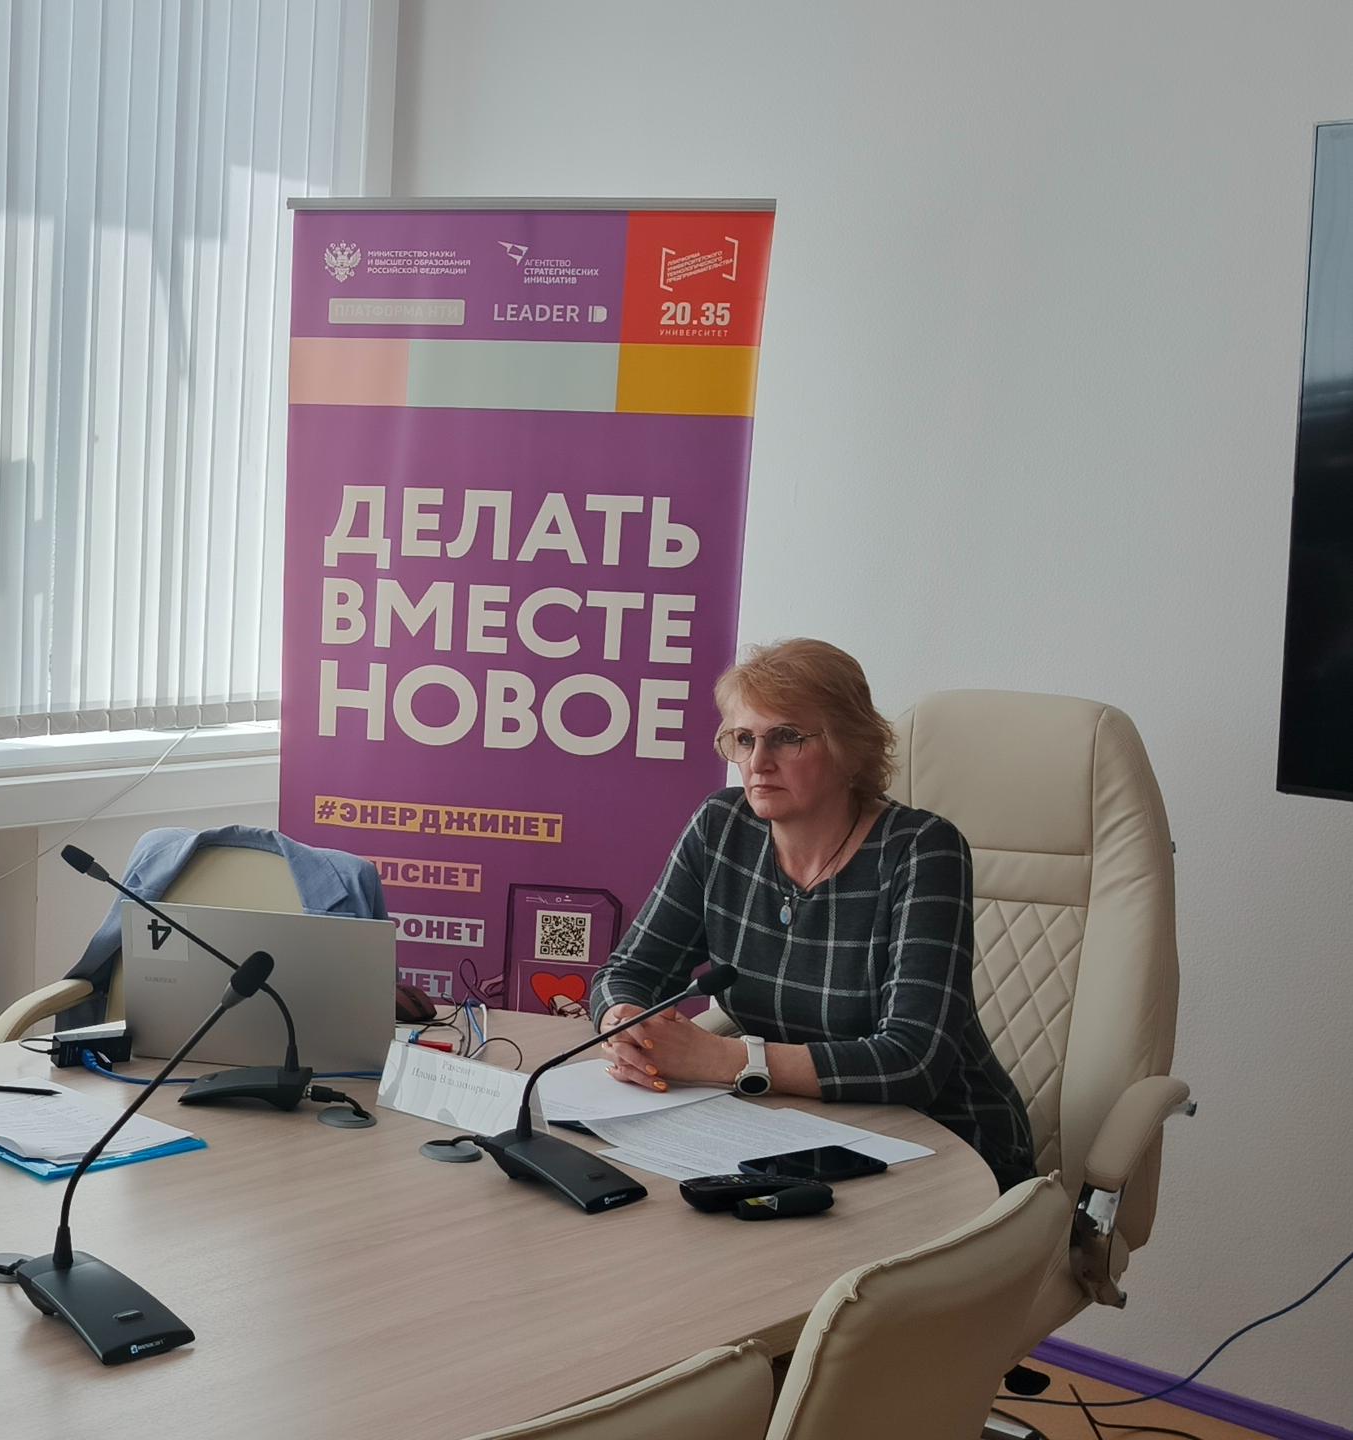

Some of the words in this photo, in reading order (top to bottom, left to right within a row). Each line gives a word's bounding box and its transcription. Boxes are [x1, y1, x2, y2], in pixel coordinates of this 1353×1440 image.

[367, 250, 427, 258] МИНИСТЕРСТВО
[429, 250, 456, 258] НАУКИ
[413, 259, 471, 267] ОБРАЗОВАНИЯ
[524, 259, 571, 268] АГЕНТСТВО
[367, 266, 418, 274] РОССИЙСКОЙ
[419, 267, 467, 275] ФЕДЕРАЦИИ
[523, 276, 577, 285] ИНИЦИАТИВ
[524, 268, 599, 276] СТРАТЕГИЧЕСКИХ
[494, 303, 580, 323] LEADER
[660, 301, 731, 326] 20.35
[659, 329, 729, 337] УНИВЕРСИТЕТ
[323, 485, 700, 570] ДЕЛАТЬ
[321, 576, 696, 664] ВМЕСТЕ
[318, 659, 690, 760] НОВОЕ
[316, 800, 561, 839] #ЭНЕРДЖИНЕТ
[371, 860, 480, 888] ЛСНЕТ
[147, 919, 172, 950] 4
